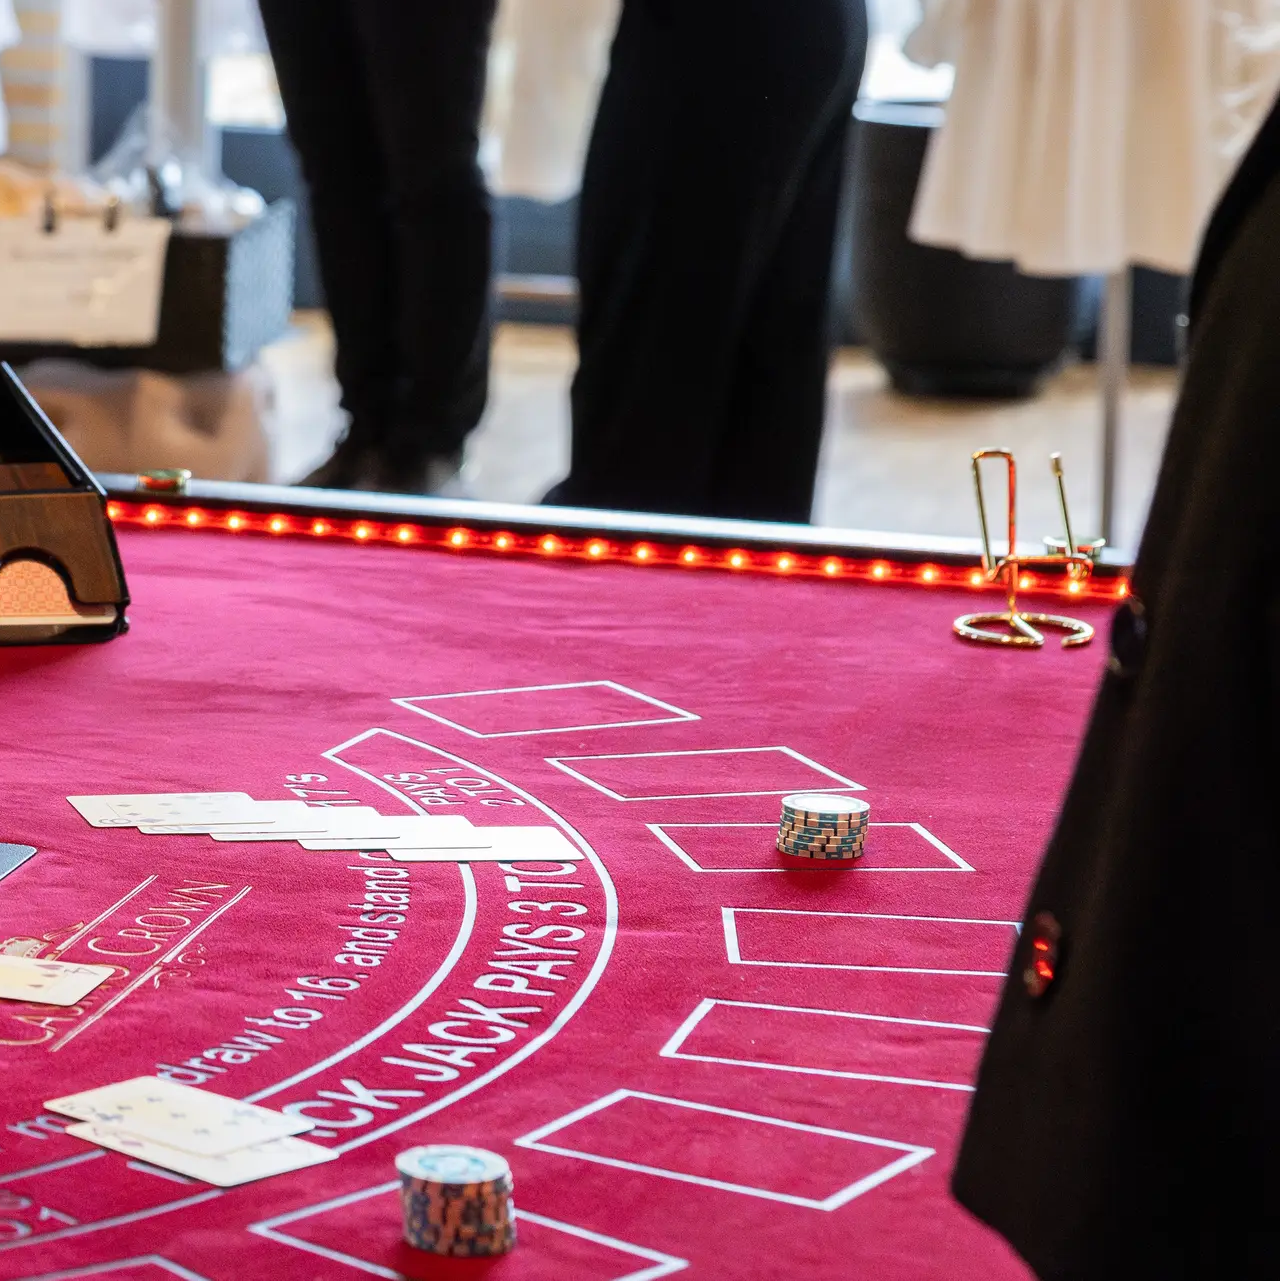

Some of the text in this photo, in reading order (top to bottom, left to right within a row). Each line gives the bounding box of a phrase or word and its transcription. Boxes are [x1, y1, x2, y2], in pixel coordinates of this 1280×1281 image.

[382, 771, 466, 807] PAYS
[445, 776, 504, 798] TO
[479, 797, 526, 808] 2
[346, 864, 411, 925] stand
[506, 899, 589, 918] 3
[87, 878, 232, 957] CROWN
[334, 924, 402, 968] and
[472, 922, 587, 997] PAYS
[244, 1006, 324, 1030] to
[380, 997, 543, 1083] JACK
[155, 1028, 285, 1086] draw
